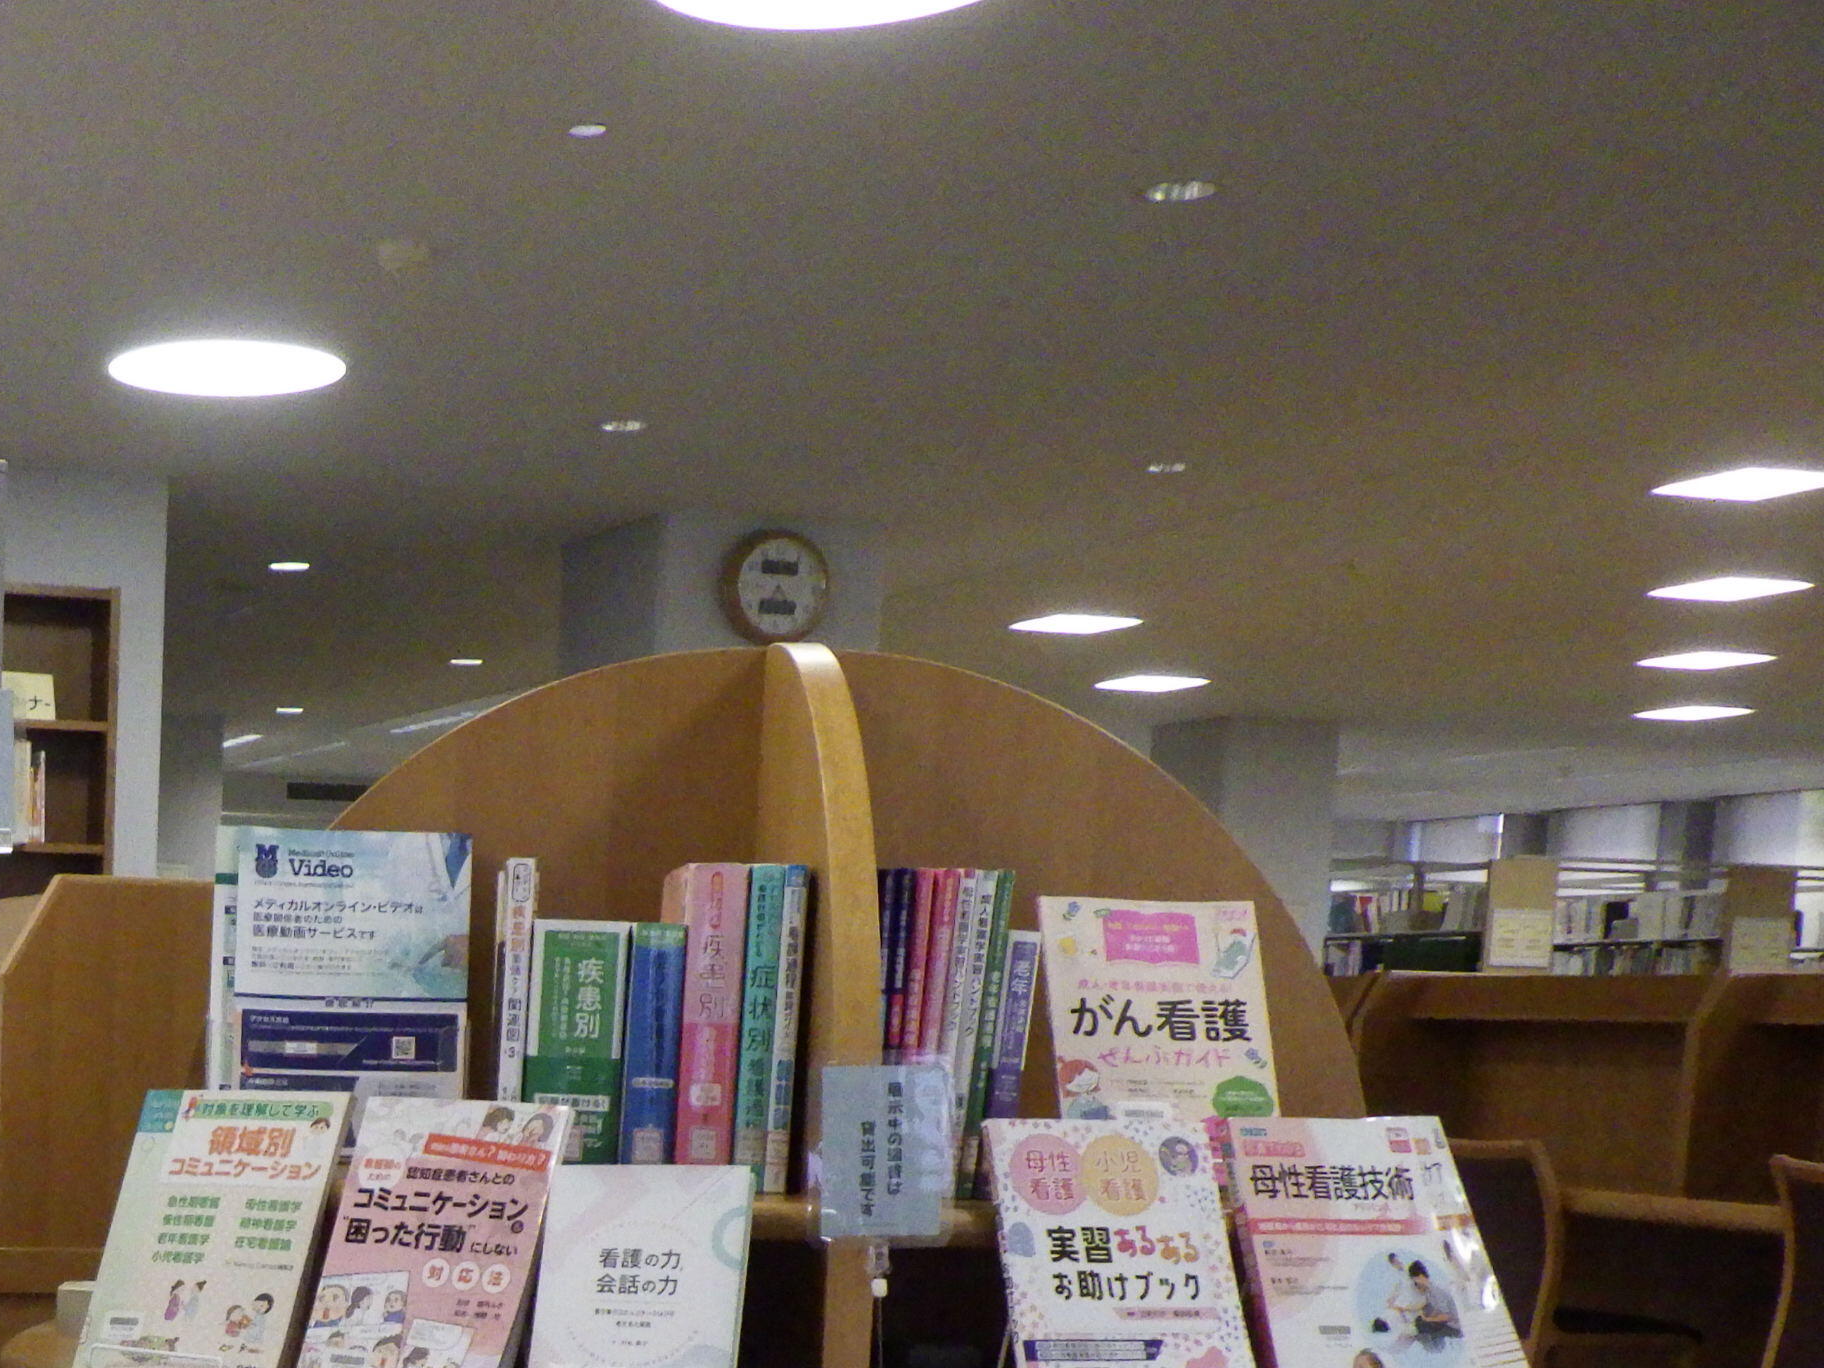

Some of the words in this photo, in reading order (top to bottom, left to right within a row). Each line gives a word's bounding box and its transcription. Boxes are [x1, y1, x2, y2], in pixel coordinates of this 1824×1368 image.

[288, 858, 354, 879] Video
[253, 900, 424, 915] メディカルオンライン・ビデオは
[253, 925, 376, 940] 医療動画サービスです
[699, 935, 725, 1018] 疾患別
[574, 957, 605, 1039] 疾患別
[1070, 994, 1252, 1043] がん看護
[1098, 1045, 1232, 1068] ぜんぶガイド
[201, 1104, 320, 1118] 対象を理解して学ぶ
[208, 1125, 297, 1158] 領域別
[169, 1157, 322, 1180] コミュニケーション
[1025, 1150, 1072, 1172] 母性
[1095, 1151, 1142, 1173] 小児
[406, 1167, 516, 1186] 認知症患者さんとの
[1250, 1163, 1414, 1201] 母性看護技術
[1030, 1178, 1073, 1200] 看護
[1100, 1179, 1148, 1201] 看護
[353, 1187, 529, 1223] コミュニケーション
[1047, 1225, 1200, 1264] 実習あるある
[596, 1273, 678, 1296] 会話の力
[1052, 1270, 1200, 1300] お助けブック
